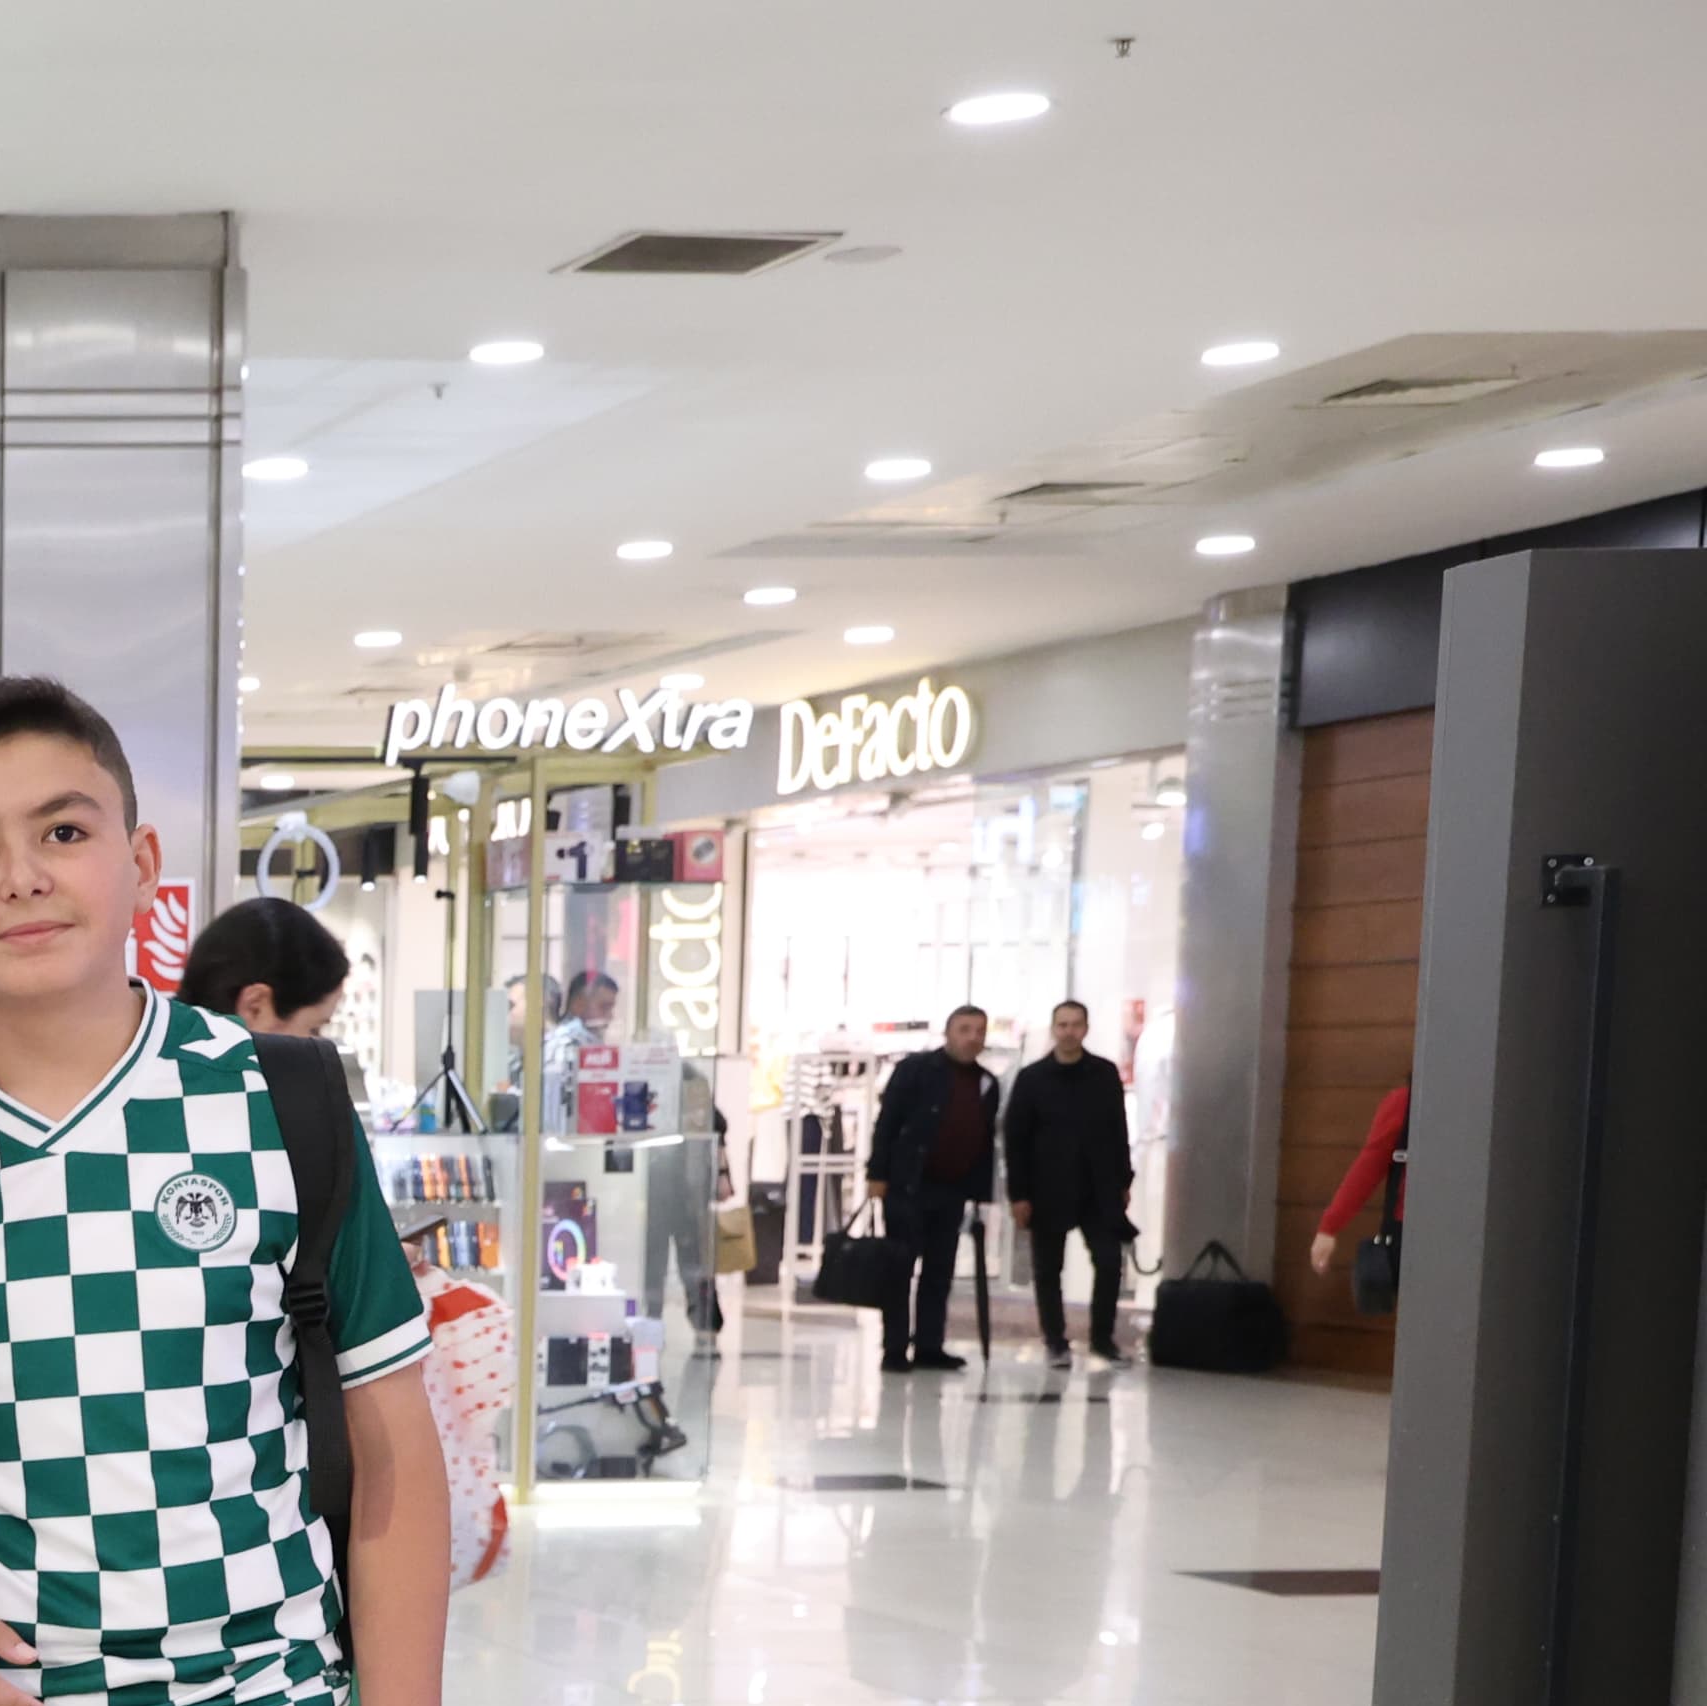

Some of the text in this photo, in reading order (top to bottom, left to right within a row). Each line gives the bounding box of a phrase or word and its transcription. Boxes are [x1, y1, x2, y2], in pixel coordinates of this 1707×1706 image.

[384, 683, 754, 766] phoneXtra
[777, 677, 971, 795] DeFacto
[161, 1178, 229, 1206] KONYASPOR
